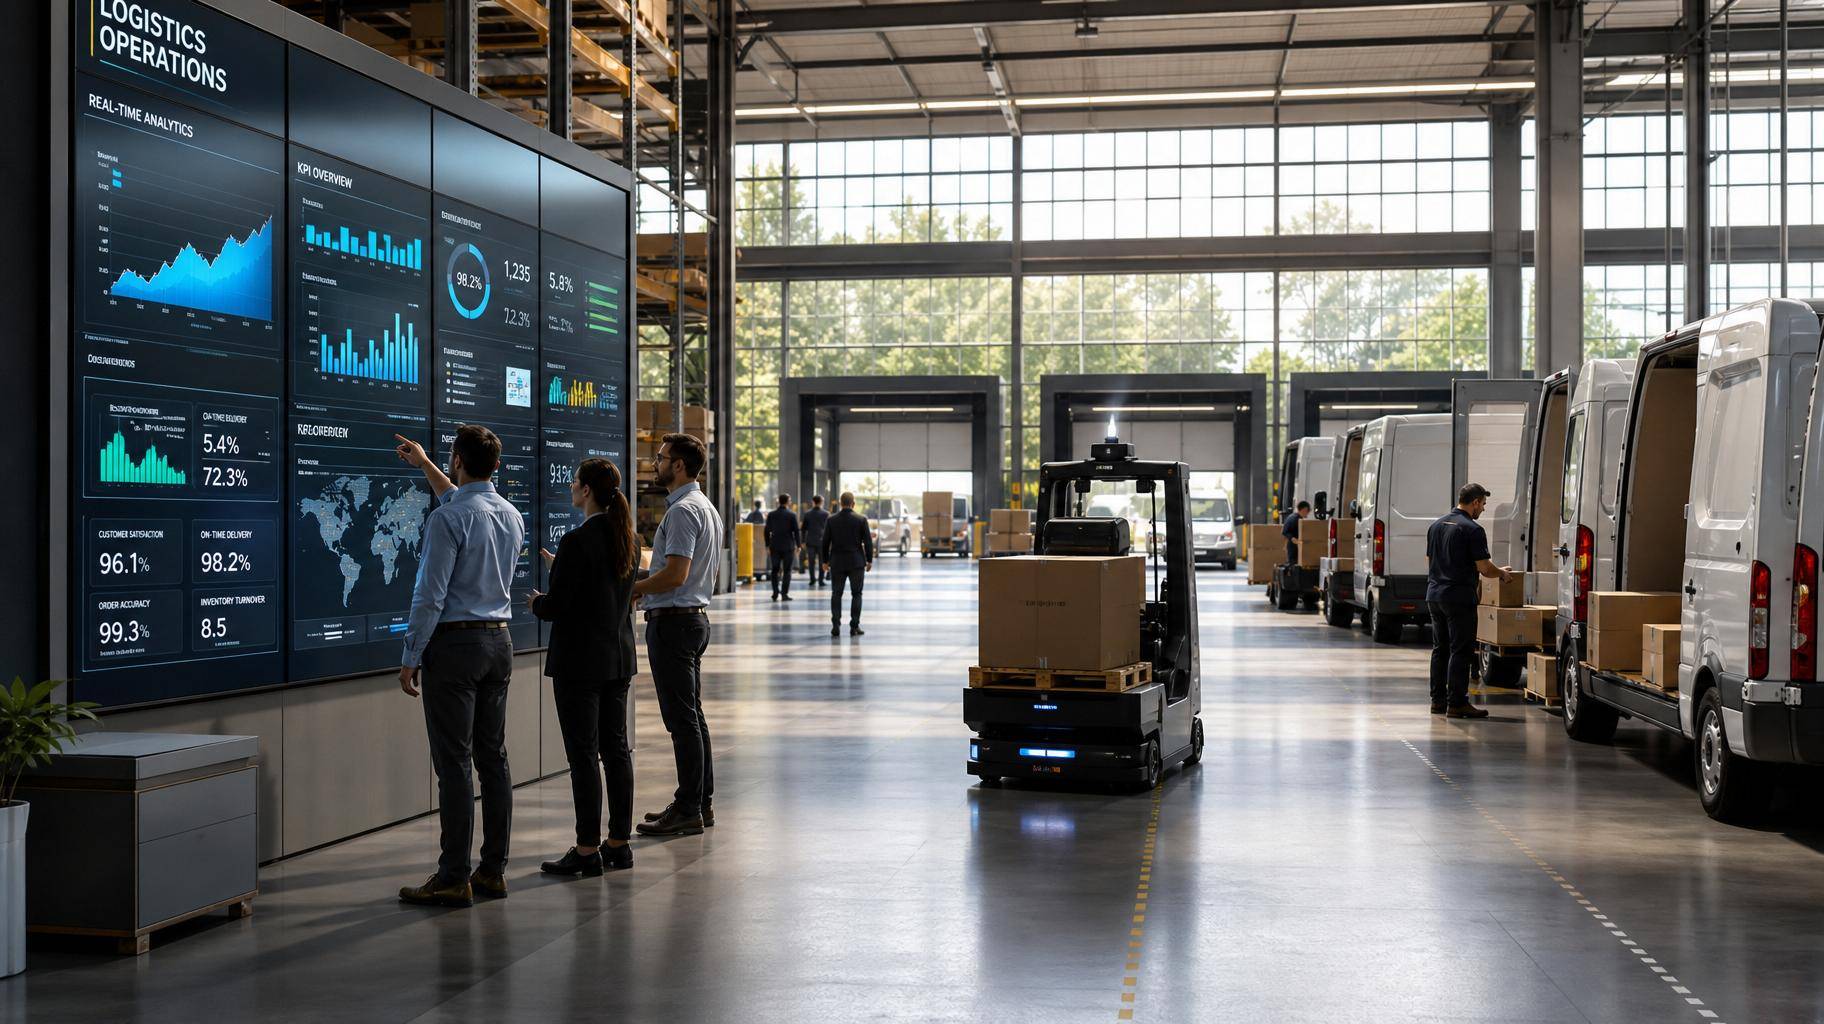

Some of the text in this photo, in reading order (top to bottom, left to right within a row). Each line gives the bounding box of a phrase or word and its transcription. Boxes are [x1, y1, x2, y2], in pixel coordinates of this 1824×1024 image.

[100, 0, 206, 54] LOGISTICS
[100, 25, 227, 92] OPERATIONS
[88, 93, 194, 138] REAL-TIME ANALYTICS
[297, 162, 353, 189] KPI OVERVIEW
[456, 271, 483, 291] 98.2%
[504, 260, 531, 283] 1,235
[549, 271, 574, 293] 5.8%
[203, 433, 240, 454] 5.4%
[203, 466, 248, 487] 72.3%
[98, 530, 164, 539] CUSTOMER SATISFACTION
[200, 530, 252, 539] ON-TIME DELIVERY
[99, 552, 150, 574] 96.1%
[201, 552, 251, 573] 98.2%
[98, 600, 151, 610] ORDER ACCURACY
[200, 595, 266, 606] INVENTORY TURNOVER
[99, 620, 150, 645] 99.3%
[201, 617, 227, 638] 8.5
